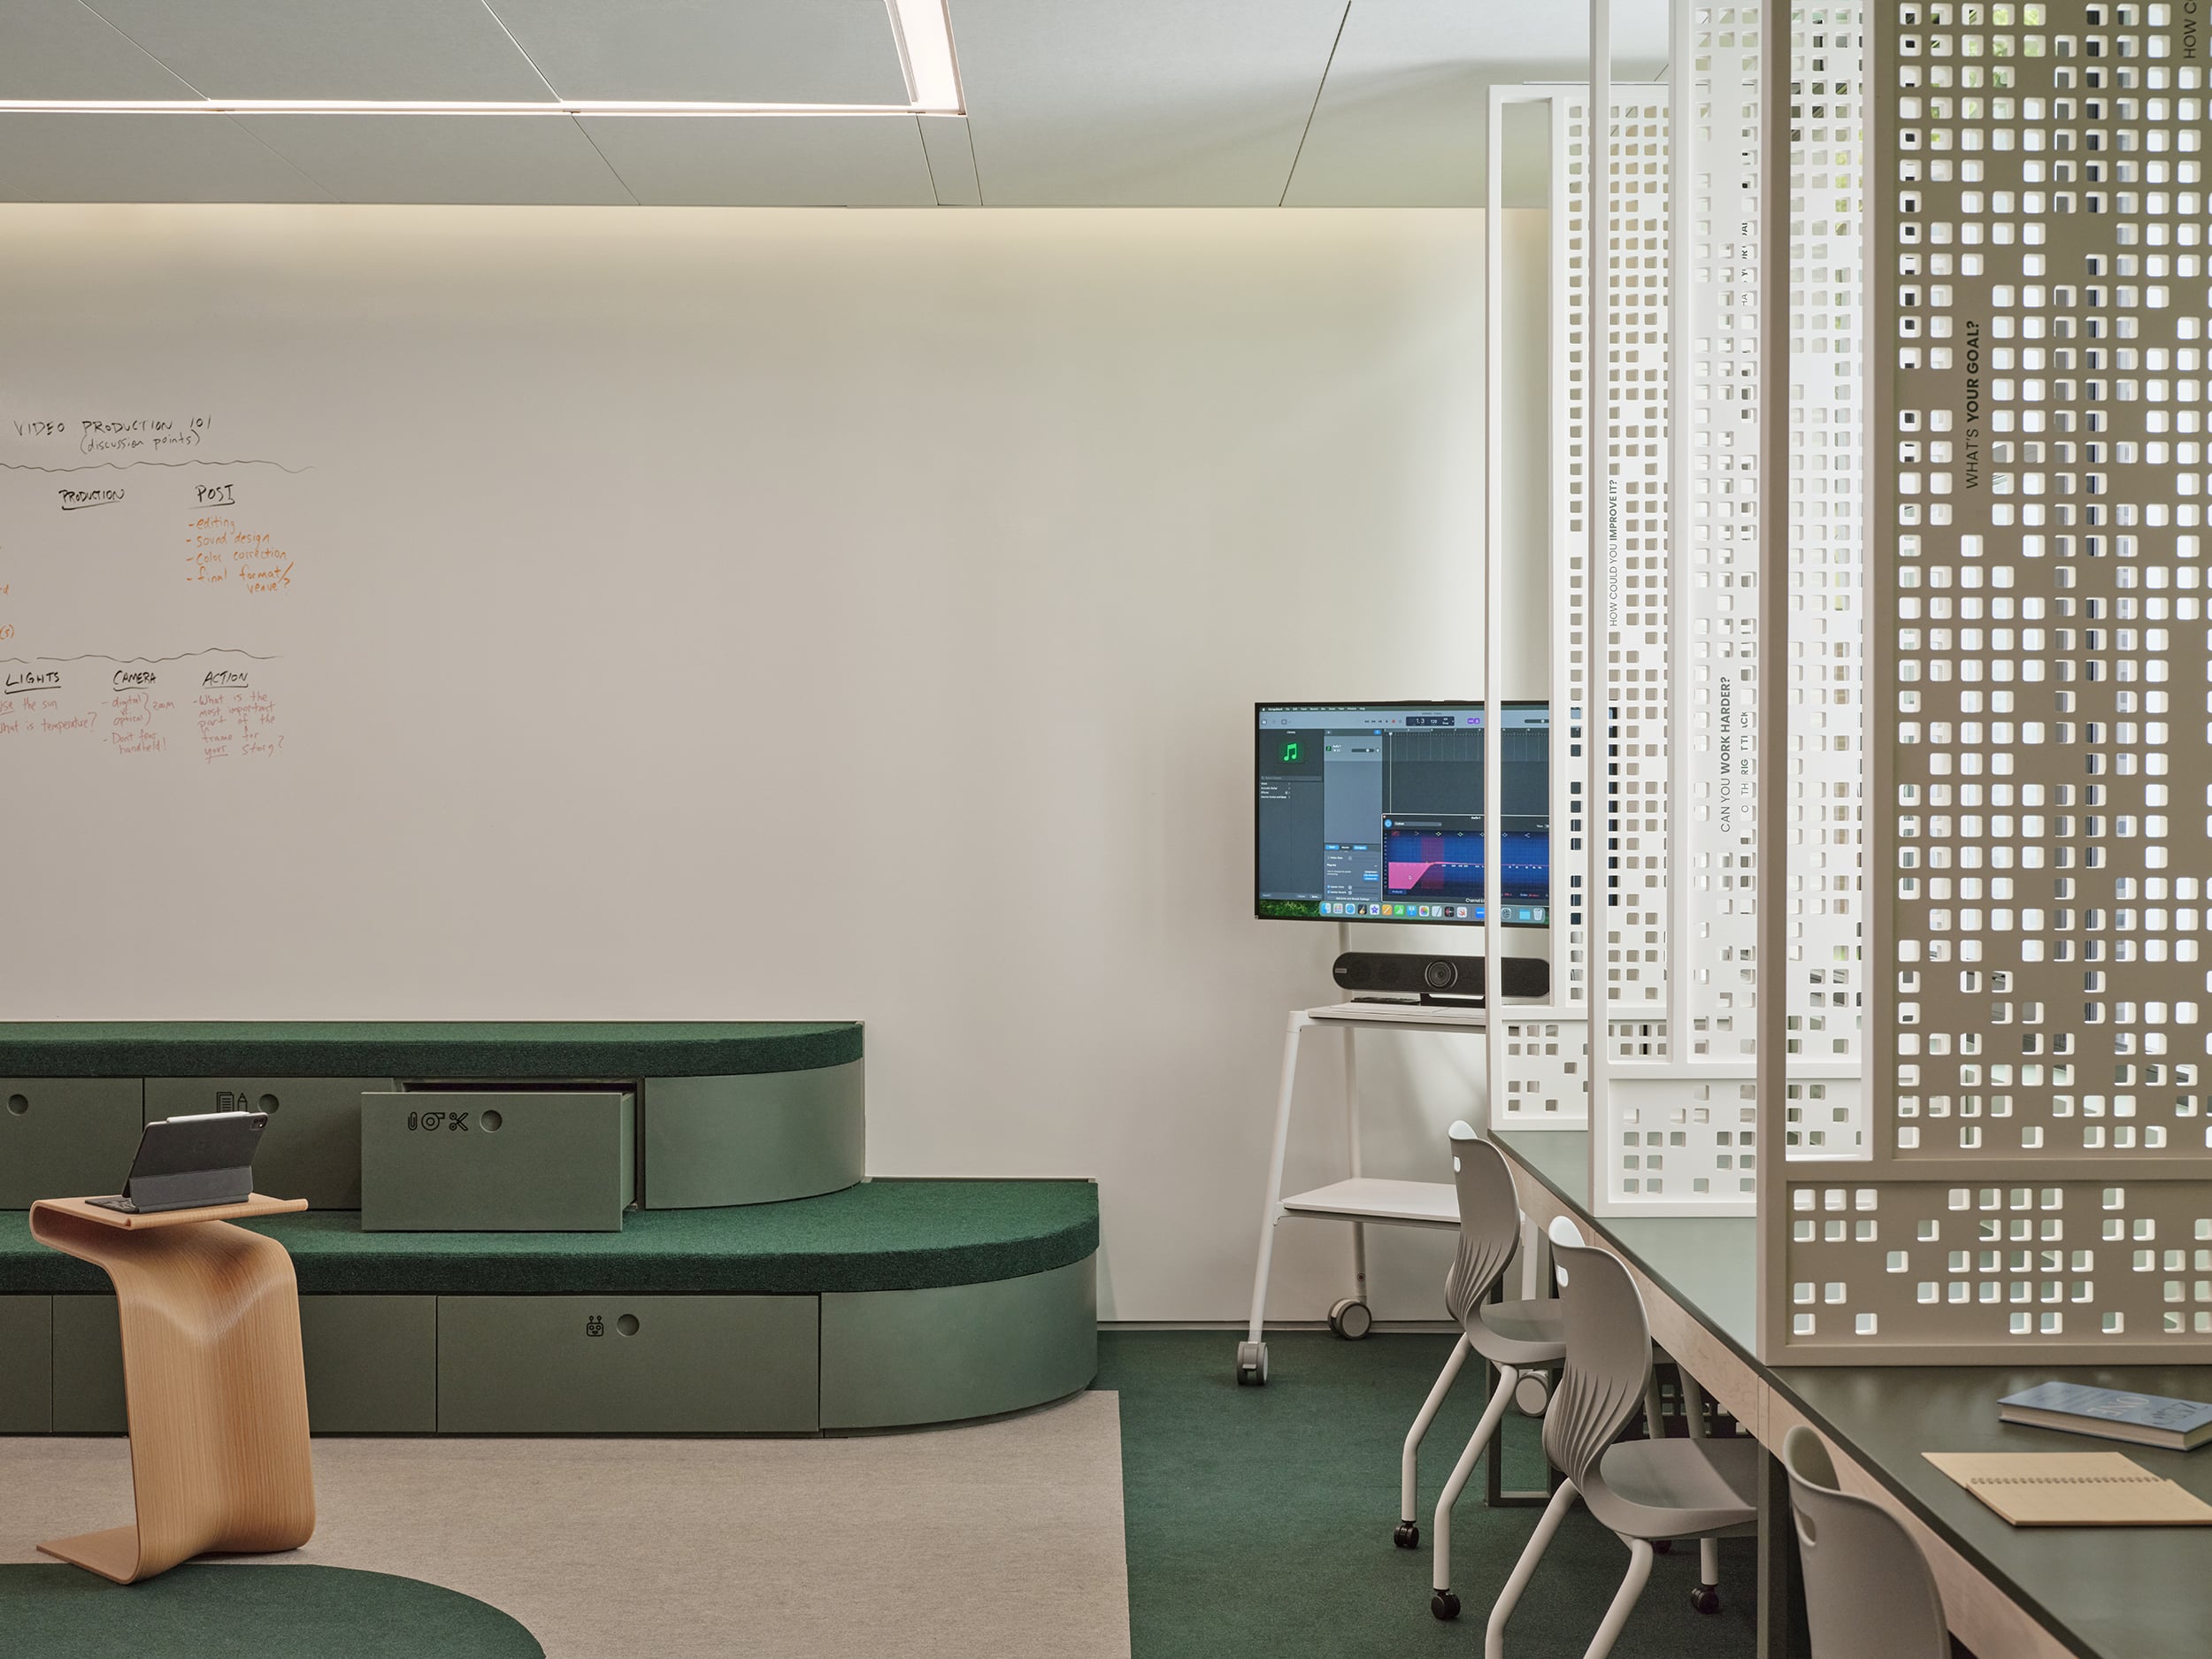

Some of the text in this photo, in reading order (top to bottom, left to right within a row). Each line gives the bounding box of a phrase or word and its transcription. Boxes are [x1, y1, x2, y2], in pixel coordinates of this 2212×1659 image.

[2183, 19, 2197, 58] HOW
[1965, 320, 1979, 489] WHAT'S YOUR GOAL?
[13, 415, 211, 436] VIDEO PRODUCTION 101
[58, 488, 125, 503] PRODUCTION
[195, 484, 234, 503] POST
[1609, 479, 1618, 626] HOW COULD YOU IMPROVE IT?
[5, 672, 60, 687] LIGHTS
[112, 670, 157, 685] CAMERA
[202, 671, 249, 687] ACTION
[1720, 676, 1731, 833] CAN YOU WORK HARDER?
